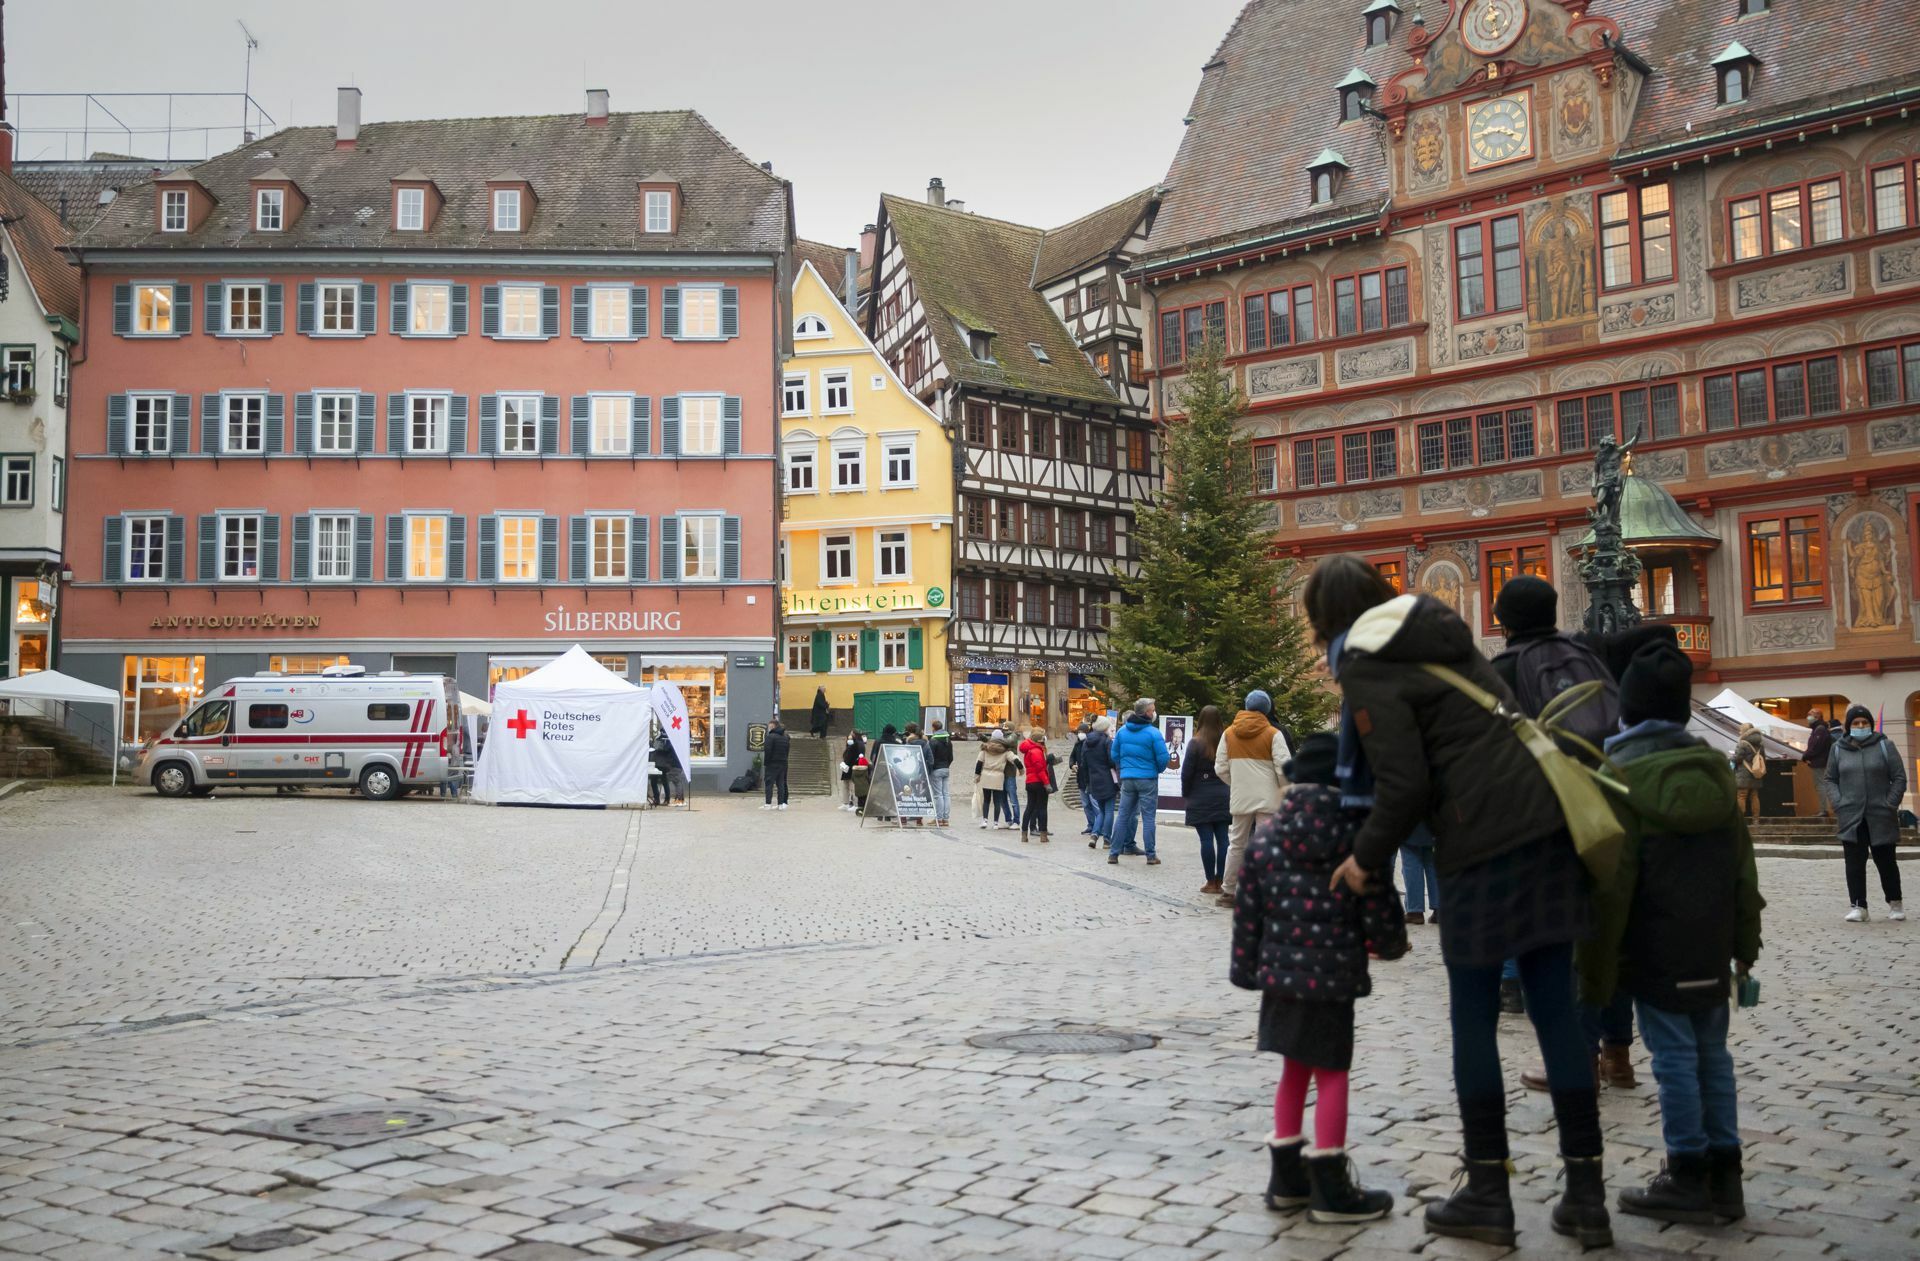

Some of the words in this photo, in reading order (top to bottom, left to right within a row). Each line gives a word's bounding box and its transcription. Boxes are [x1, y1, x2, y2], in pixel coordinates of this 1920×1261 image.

[783, 590, 914, 613] htenstein
[150, 612, 321, 628] ANTIQUITÄTEN
[543, 710, 602, 722] Deutsches
[543, 721, 575, 731] Rotes
[542, 731, 574, 742] Kreuz
